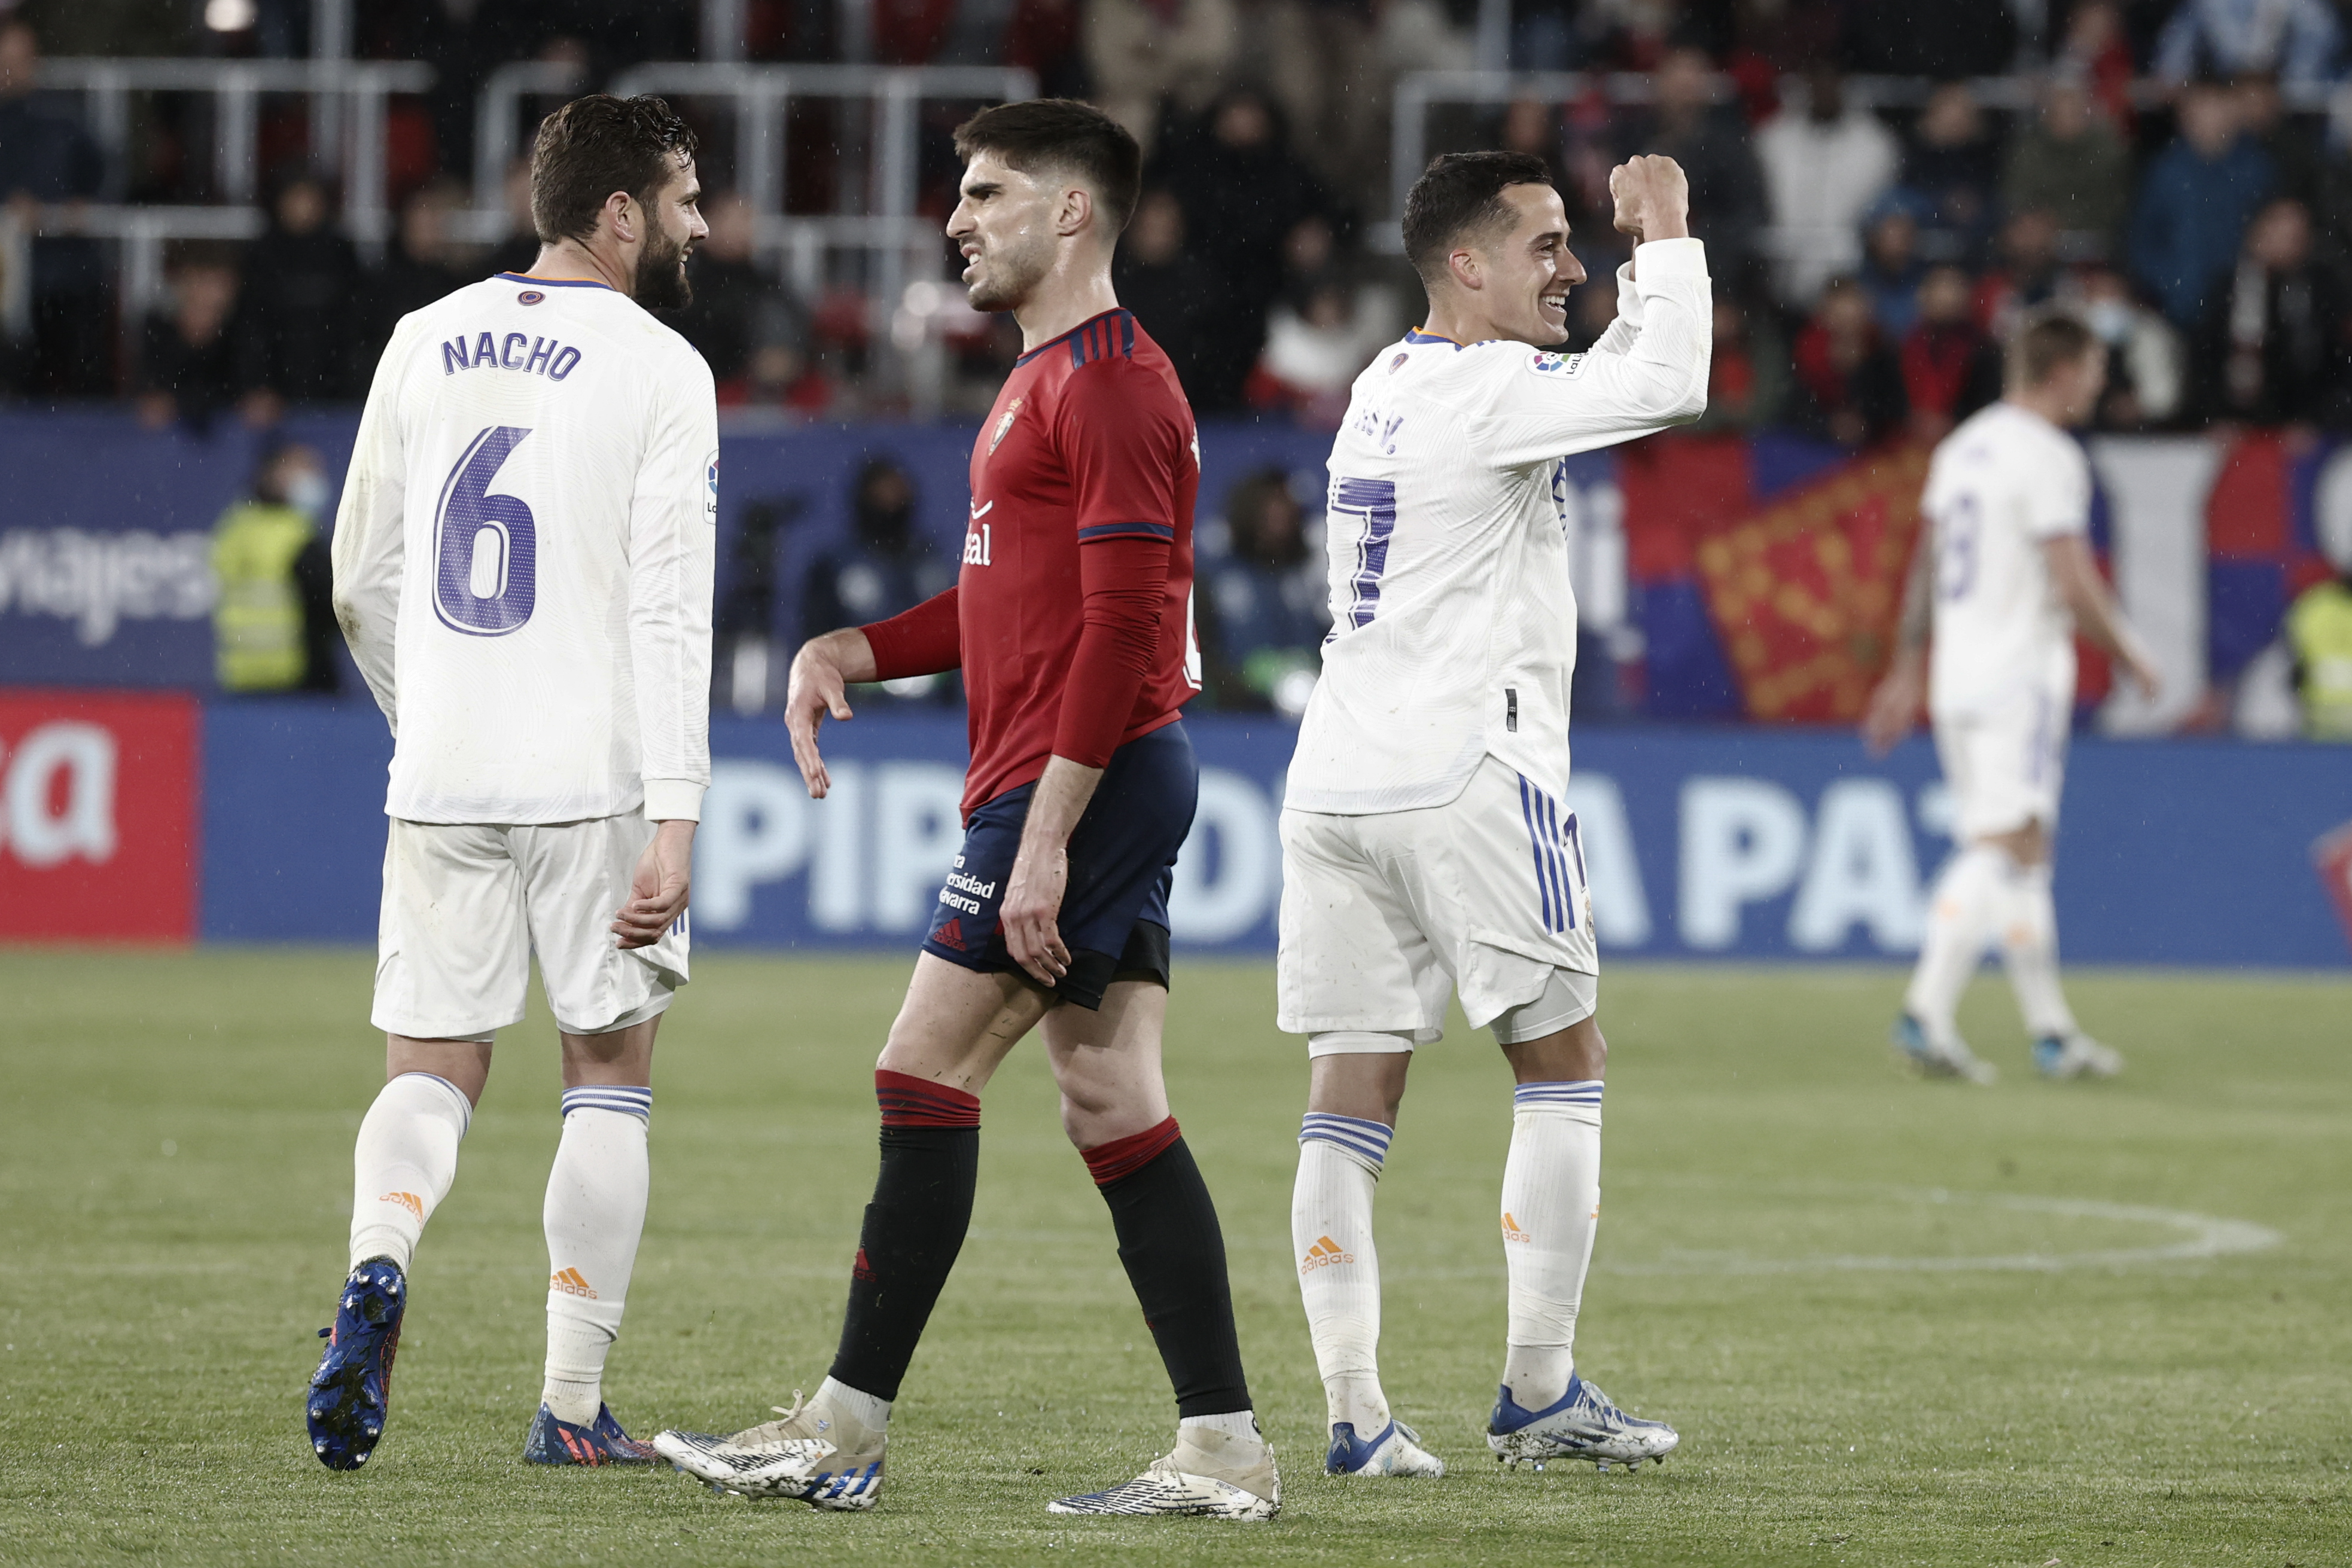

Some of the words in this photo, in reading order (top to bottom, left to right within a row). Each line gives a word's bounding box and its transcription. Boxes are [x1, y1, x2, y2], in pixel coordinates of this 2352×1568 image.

[441, 331, 581, 382] NACHO
[432, 425, 536, 637] 6
[1329, 477, 1397, 632] 7
[0, 721, 117, 868] a
[691, 758, 968, 933] PIP
[946, 872, 996, 899] ersidad
[1301, 1253, 1354, 1275] adidas
[1504, 1230, 1530, 1243] das
